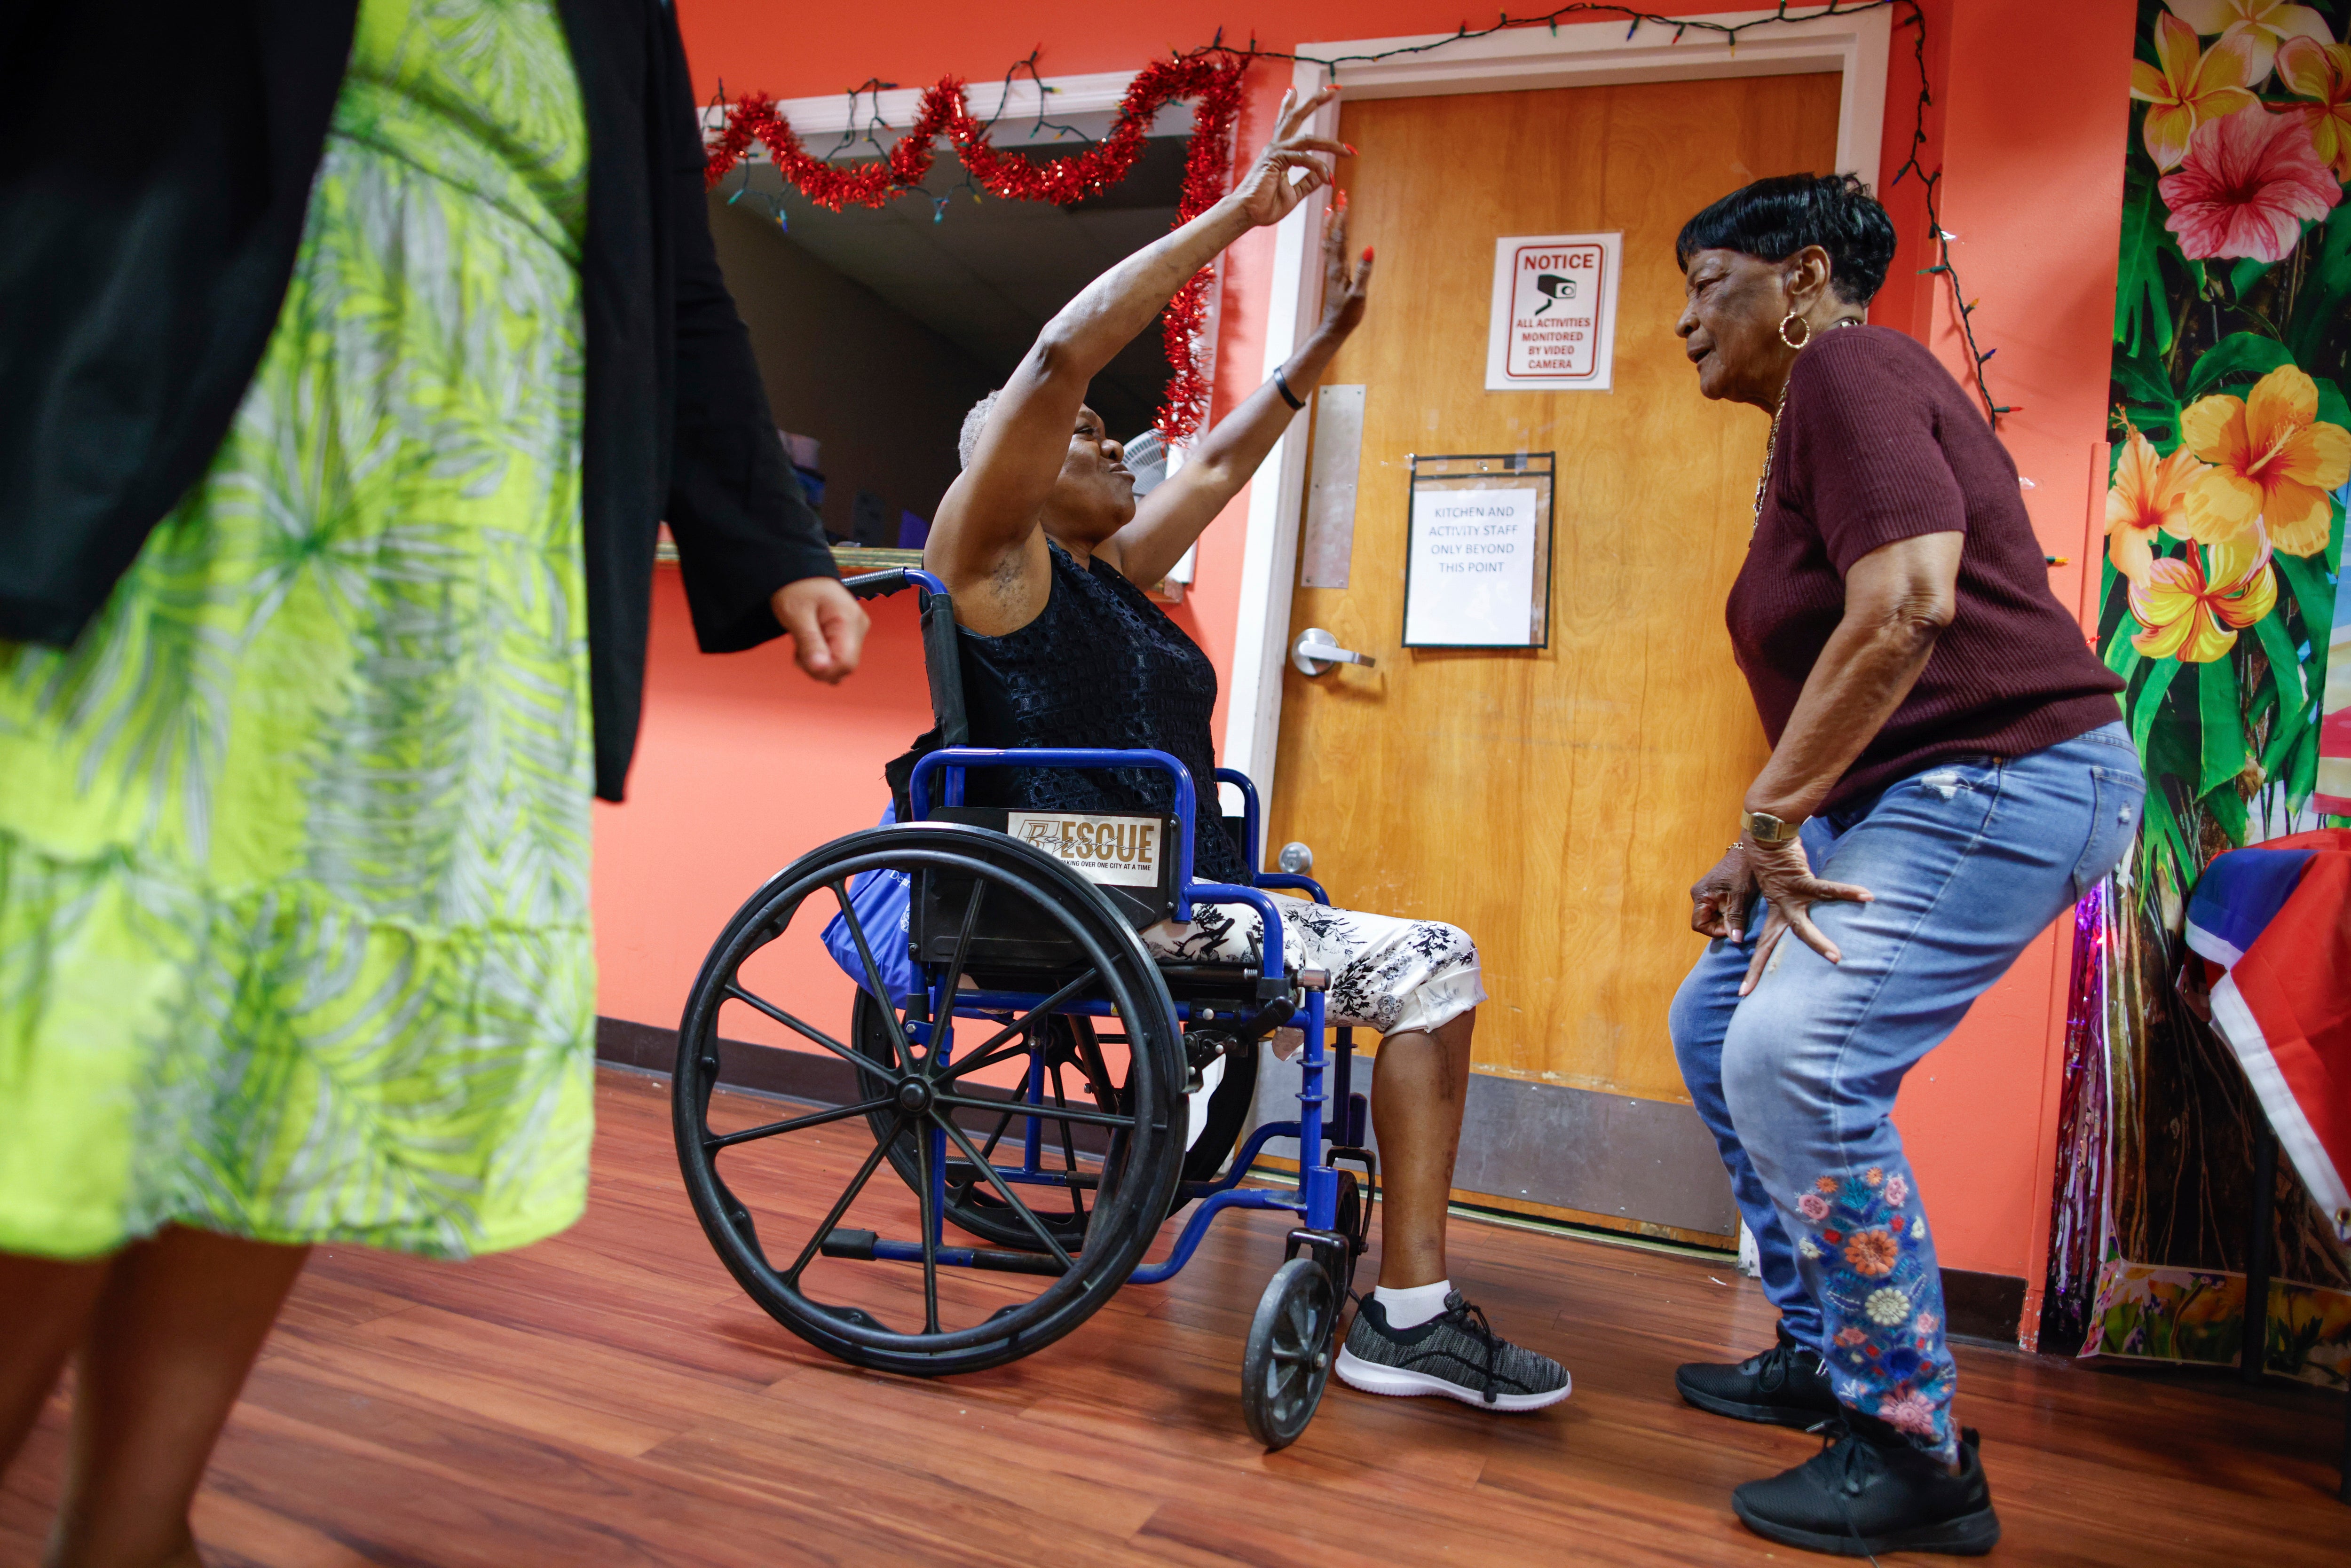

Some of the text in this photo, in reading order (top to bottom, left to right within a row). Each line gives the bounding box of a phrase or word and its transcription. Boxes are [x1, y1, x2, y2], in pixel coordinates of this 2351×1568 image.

[1524, 253, 1594, 270] NOTICE
[1516, 317, 1591, 328] ALL ACTIVITIES
[1522, 331, 1583, 341] MONITORED
[1528, 346, 1575, 355] BY VIDEO
[1528, 360, 1572, 369] CAMERA
[1435, 506, 1514, 518] KITCHEN AND
[1429, 525, 1518, 536] ACTIVITY STAFF
[1431, 544, 1514, 554] ONLY BEYOND
[1439, 562, 1504, 573] THIS POINT
